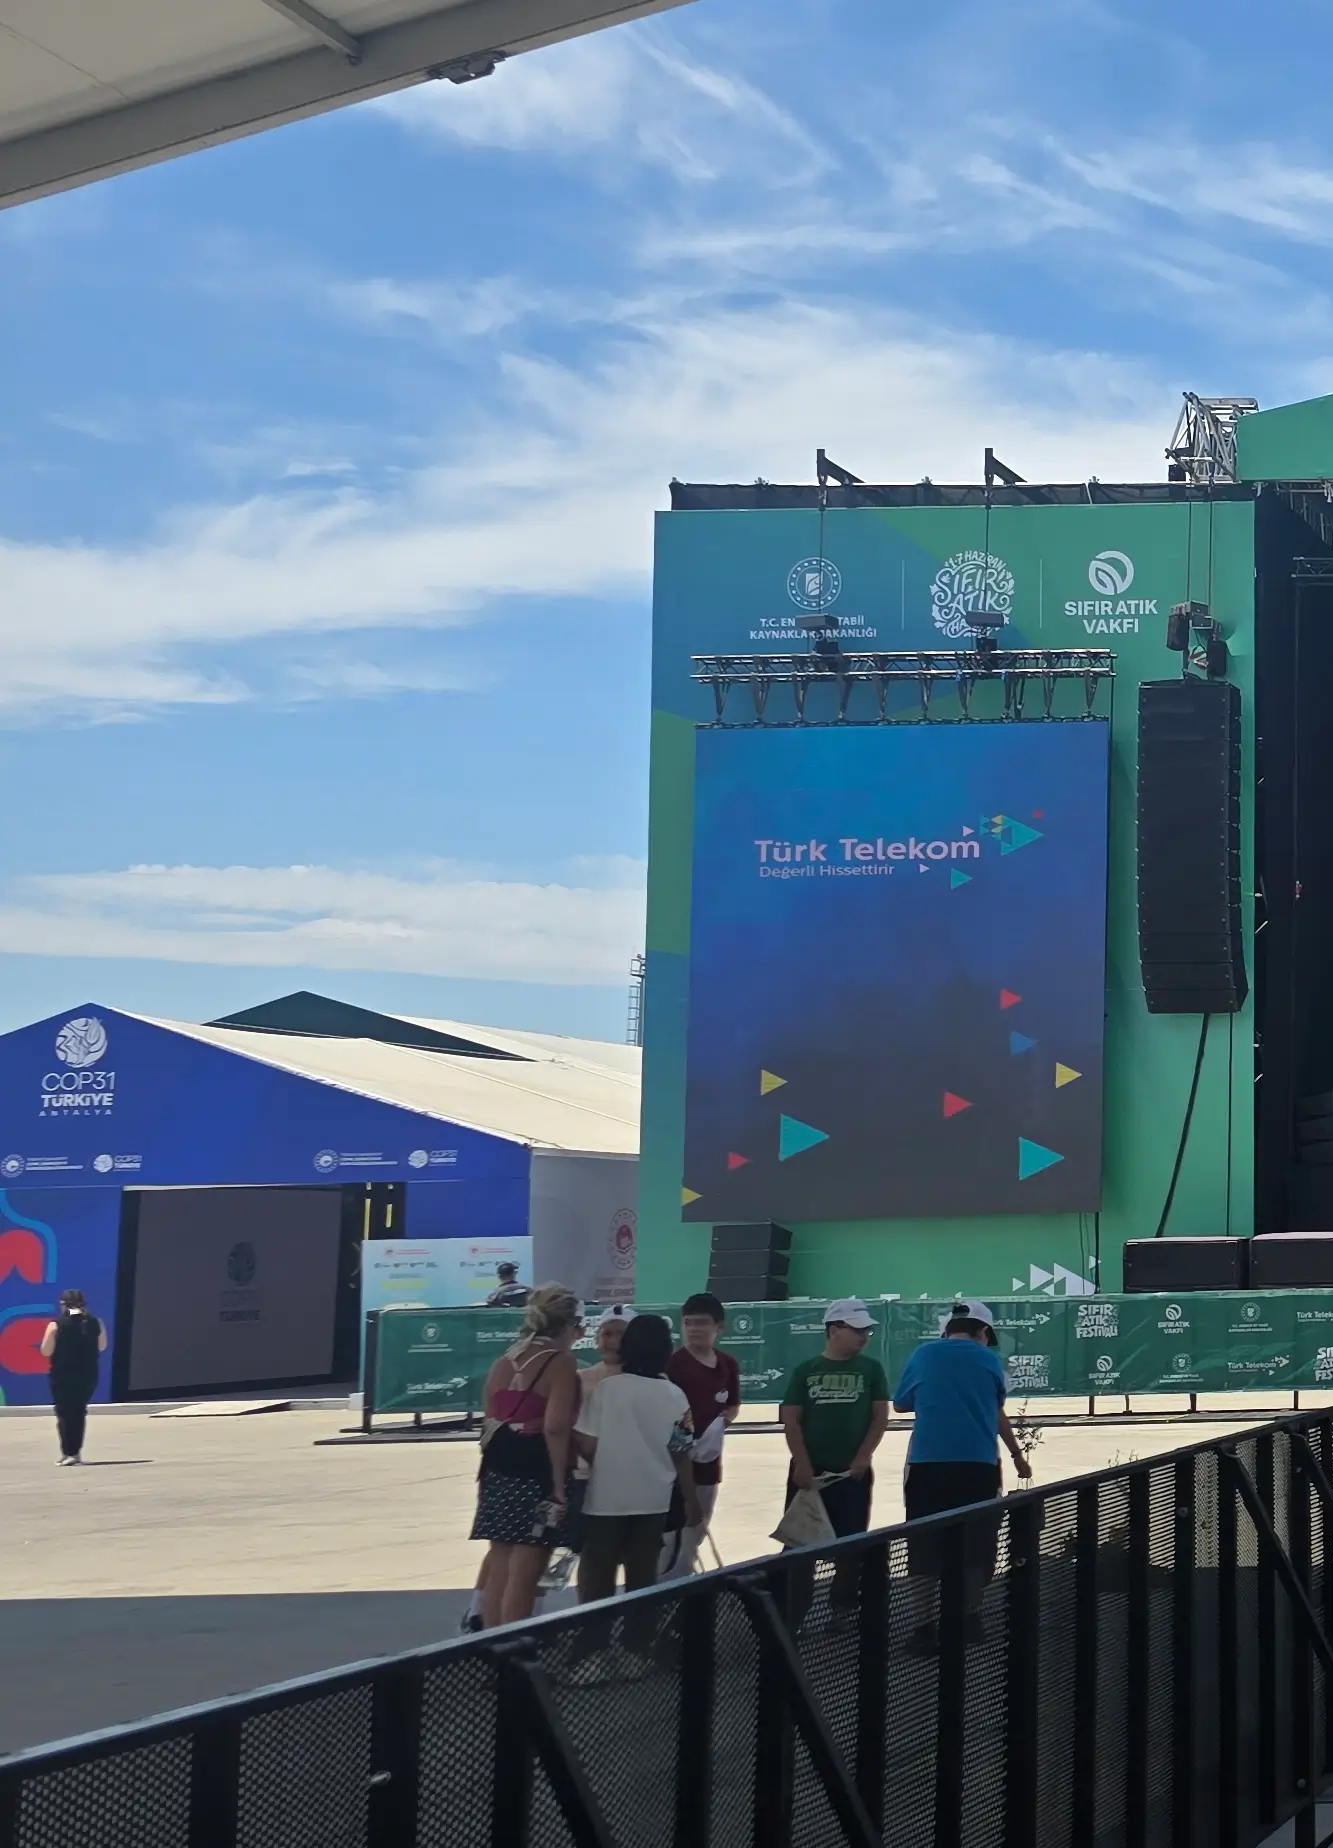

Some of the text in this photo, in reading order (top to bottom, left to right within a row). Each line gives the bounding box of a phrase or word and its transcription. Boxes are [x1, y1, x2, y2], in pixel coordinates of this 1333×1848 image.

[934, 568, 1009, 605] SIFIR
[942, 591, 1010, 619] ATIK
[1064, 599, 1158, 616] SIFIR ATIK
[1083, 619, 1139, 634] VAKFI
[754, 837, 980, 863] Türk Telekom
[759, 863, 895, 879] Değerli Hissettirir
[41, 1072, 116, 1091] COP31
[41, 1093, 114, 1108] TÜRKİYE
[39, 1109, 112, 1117] ANTALYA
[1078, 1304, 1114, 1317] SIFIR
[1297, 1311, 1312, 1319] Türk
[1081, 1314, 1110, 1326] ATIK
[1008, 1354, 1045, 1367] SIFIR
